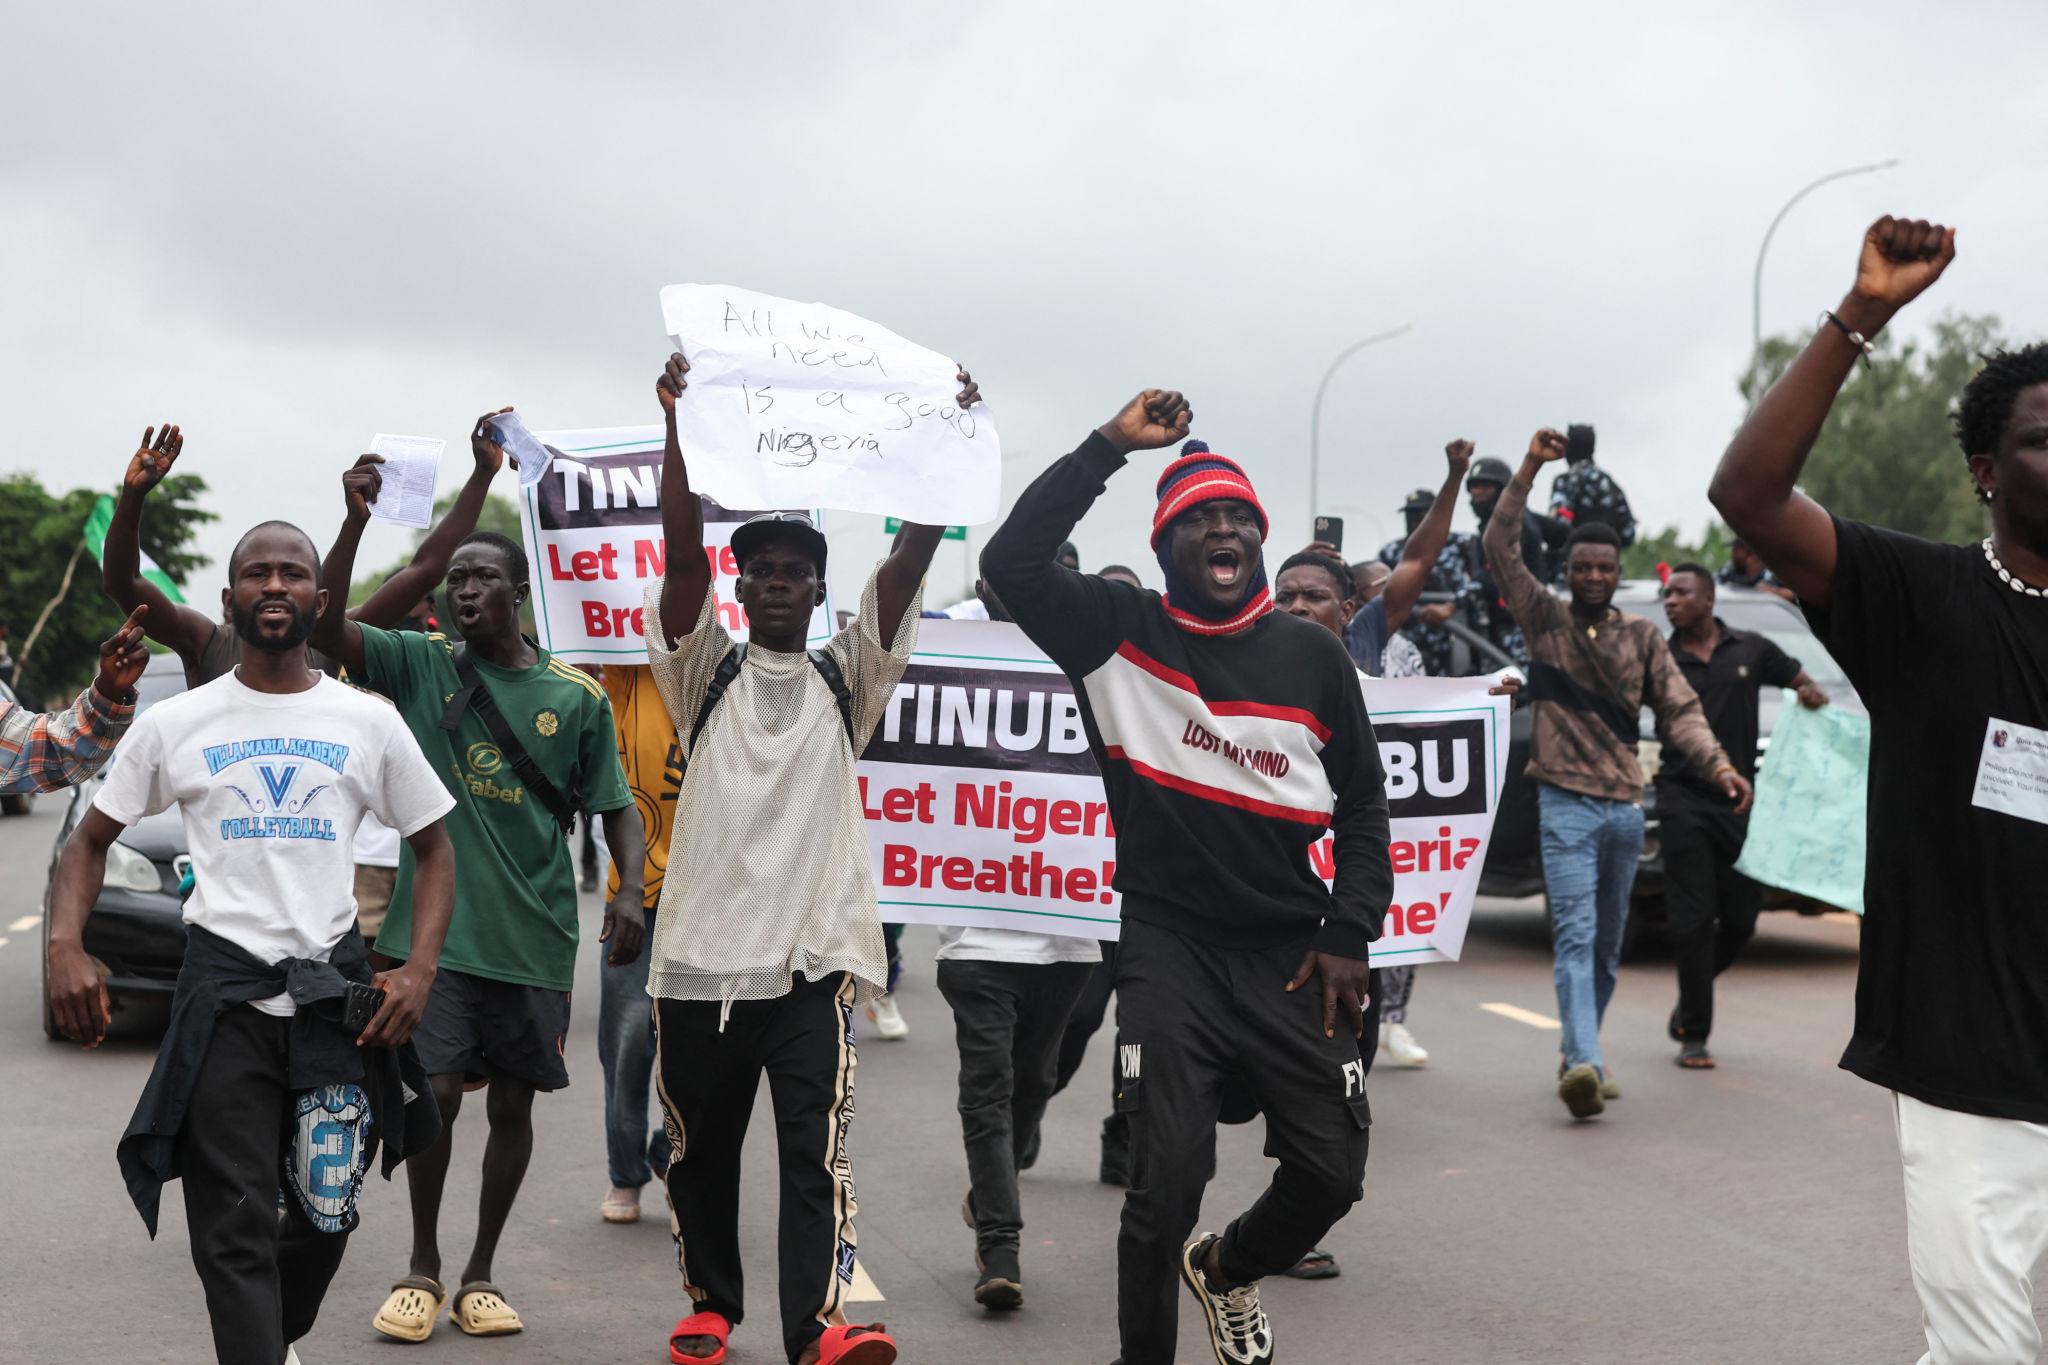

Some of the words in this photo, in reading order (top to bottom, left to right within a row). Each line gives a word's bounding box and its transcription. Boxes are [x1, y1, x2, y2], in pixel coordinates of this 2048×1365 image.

[724, 301, 775, 337] All
[742, 378, 775, 415] is
[816, 390, 859, 416] a
[757, 426, 883, 468] Nigeria
[552, 458, 663, 512] TIN
[547, 541, 618, 582] Let
[202, 742, 245, 777] VILLA
[243, 738, 287, 758] MARIA
[287, 738, 350, 776] ACADEMY
[1181, 719, 1221, 754] LOST
[1223, 740, 1246, 768] MY
[1246, 748, 1290, 779] MIND
[250, 761, 304, 813] V
[856, 776, 937, 825] Let
[219, 816, 337, 841] VOLLEYBALL
[882, 843, 1116, 905] Breathe!
[1341, 1058, 1367, 1098] FY
[309, 1120, 353, 1199] 2
